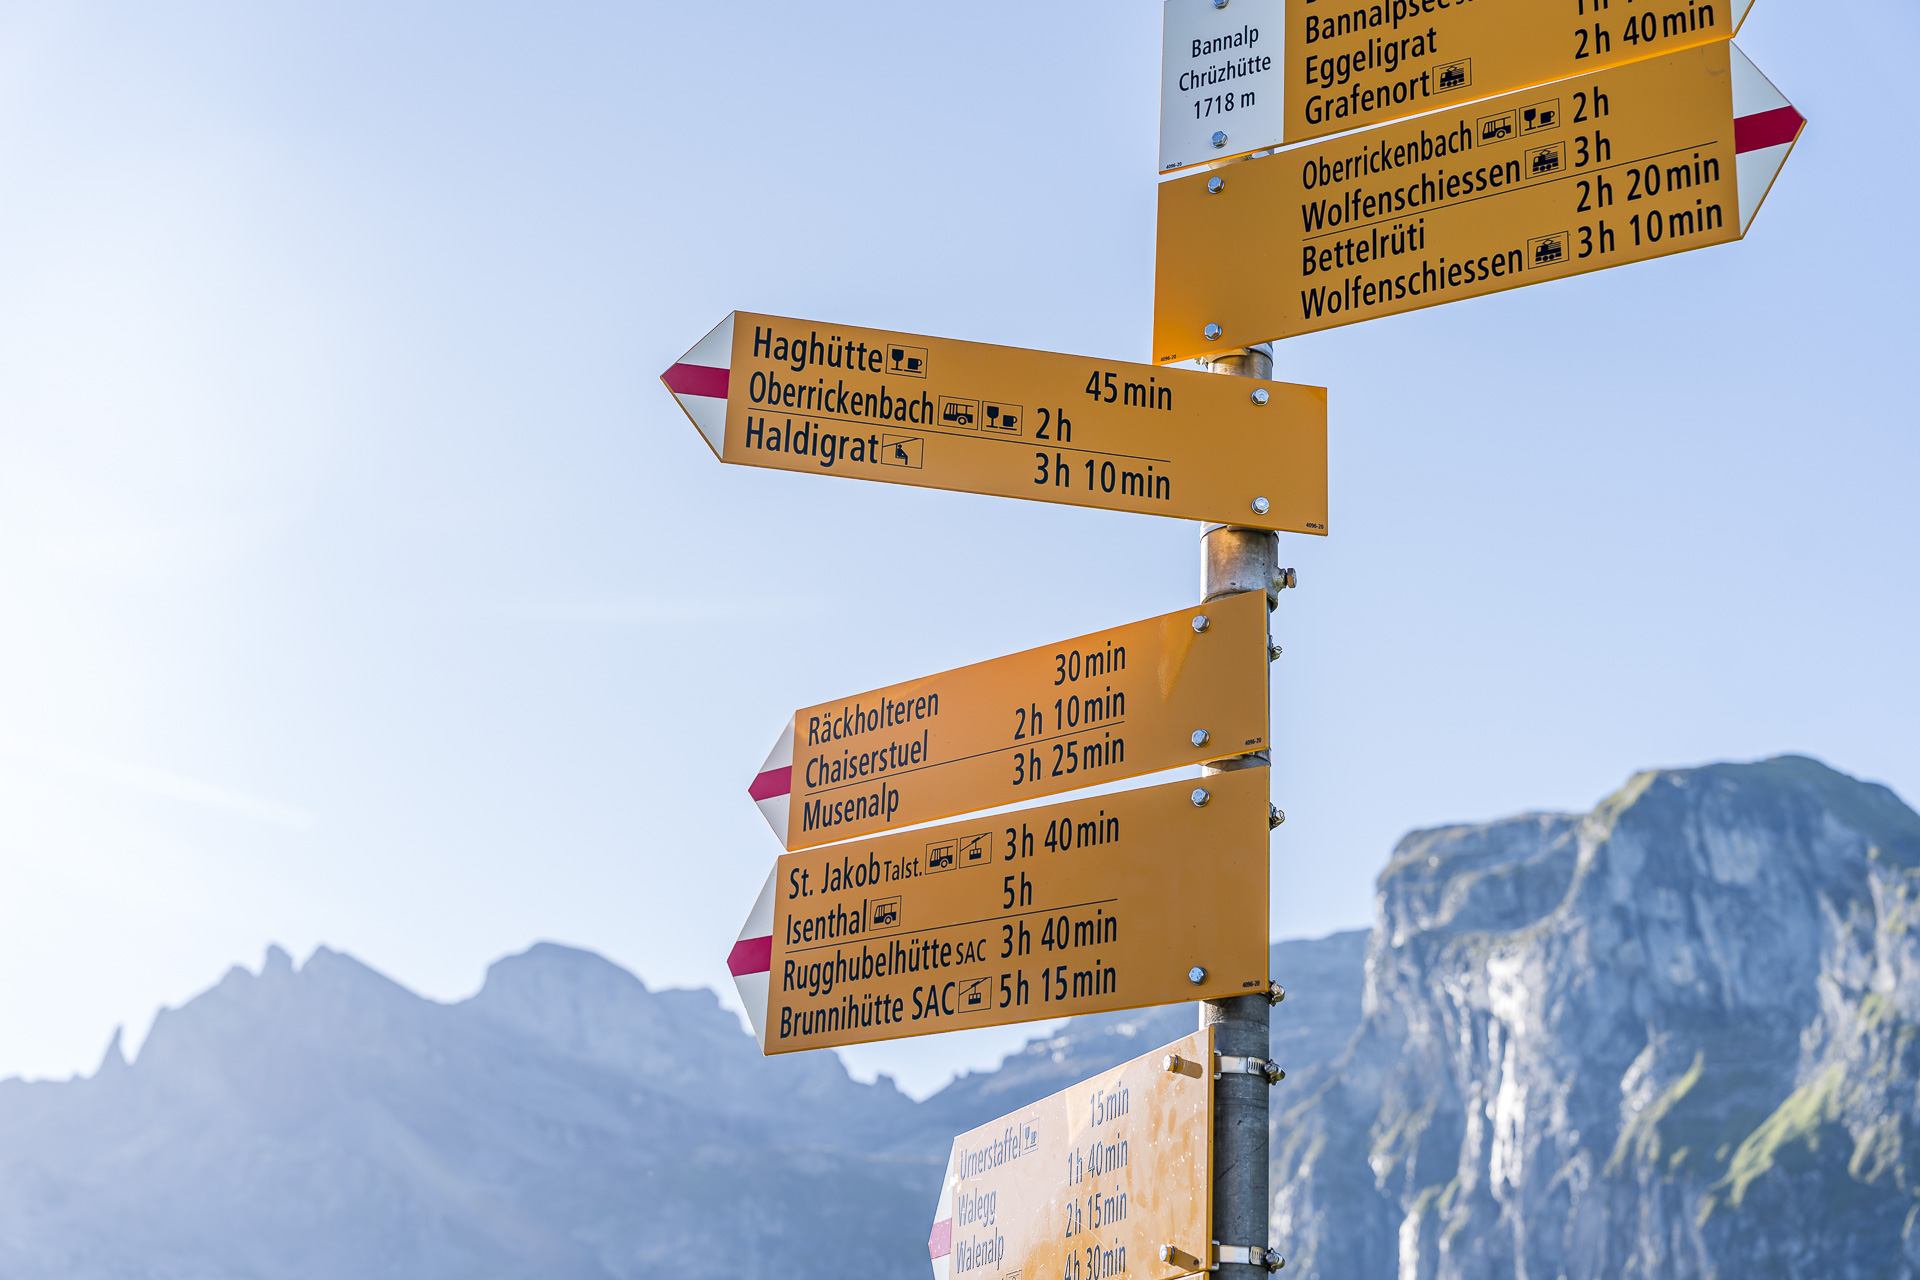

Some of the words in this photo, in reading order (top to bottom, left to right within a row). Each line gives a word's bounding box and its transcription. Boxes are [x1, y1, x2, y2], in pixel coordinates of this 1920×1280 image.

[1192, 25, 1258, 58] Bannalp
[1307, 27, 1437, 88] Eggeligrat
[1180, 56, 1271, 91] Chrüzhütte
[1306, 71, 1430, 124] Grafenort
[1194, 93, 1234, 119] 1718
[1241, 92, 1254, 108] m
[1303, 120, 1471, 189] Oberrickenbach
[1302, 160, 1520, 232] Wolfenschiessen
[1303, 218, 1424, 276] Bettelrüti
[1301, 250, 1522, 319] Wolfenschiessen
[754, 326, 882, 372] Haghütte
[750, 371, 933, 425] Oberrickenbach
[746, 416, 878, 467] Haldigrat
[809, 694, 938, 746] Räckholteren
[806, 729, 928, 788] Chaiserstuel
[803, 782, 898, 832] Musenalp
[789, 868, 813, 899] St.
[821, 852, 880, 893] Jakob
[884, 857, 922, 882] Talst.
[787, 899, 867, 945] Isenthal
[784, 939, 951, 997] Rugghubelhütte
[956, 939, 986, 965] SAC
[780, 993, 903, 1038] Brunnihütte
[912, 982, 955, 1020] SAC
[960, 1123, 1022, 1181] Urnerstaffel
[958, 1187, 997, 1228] Walegg
[956, 1226, 1005, 1275] Walenalp
